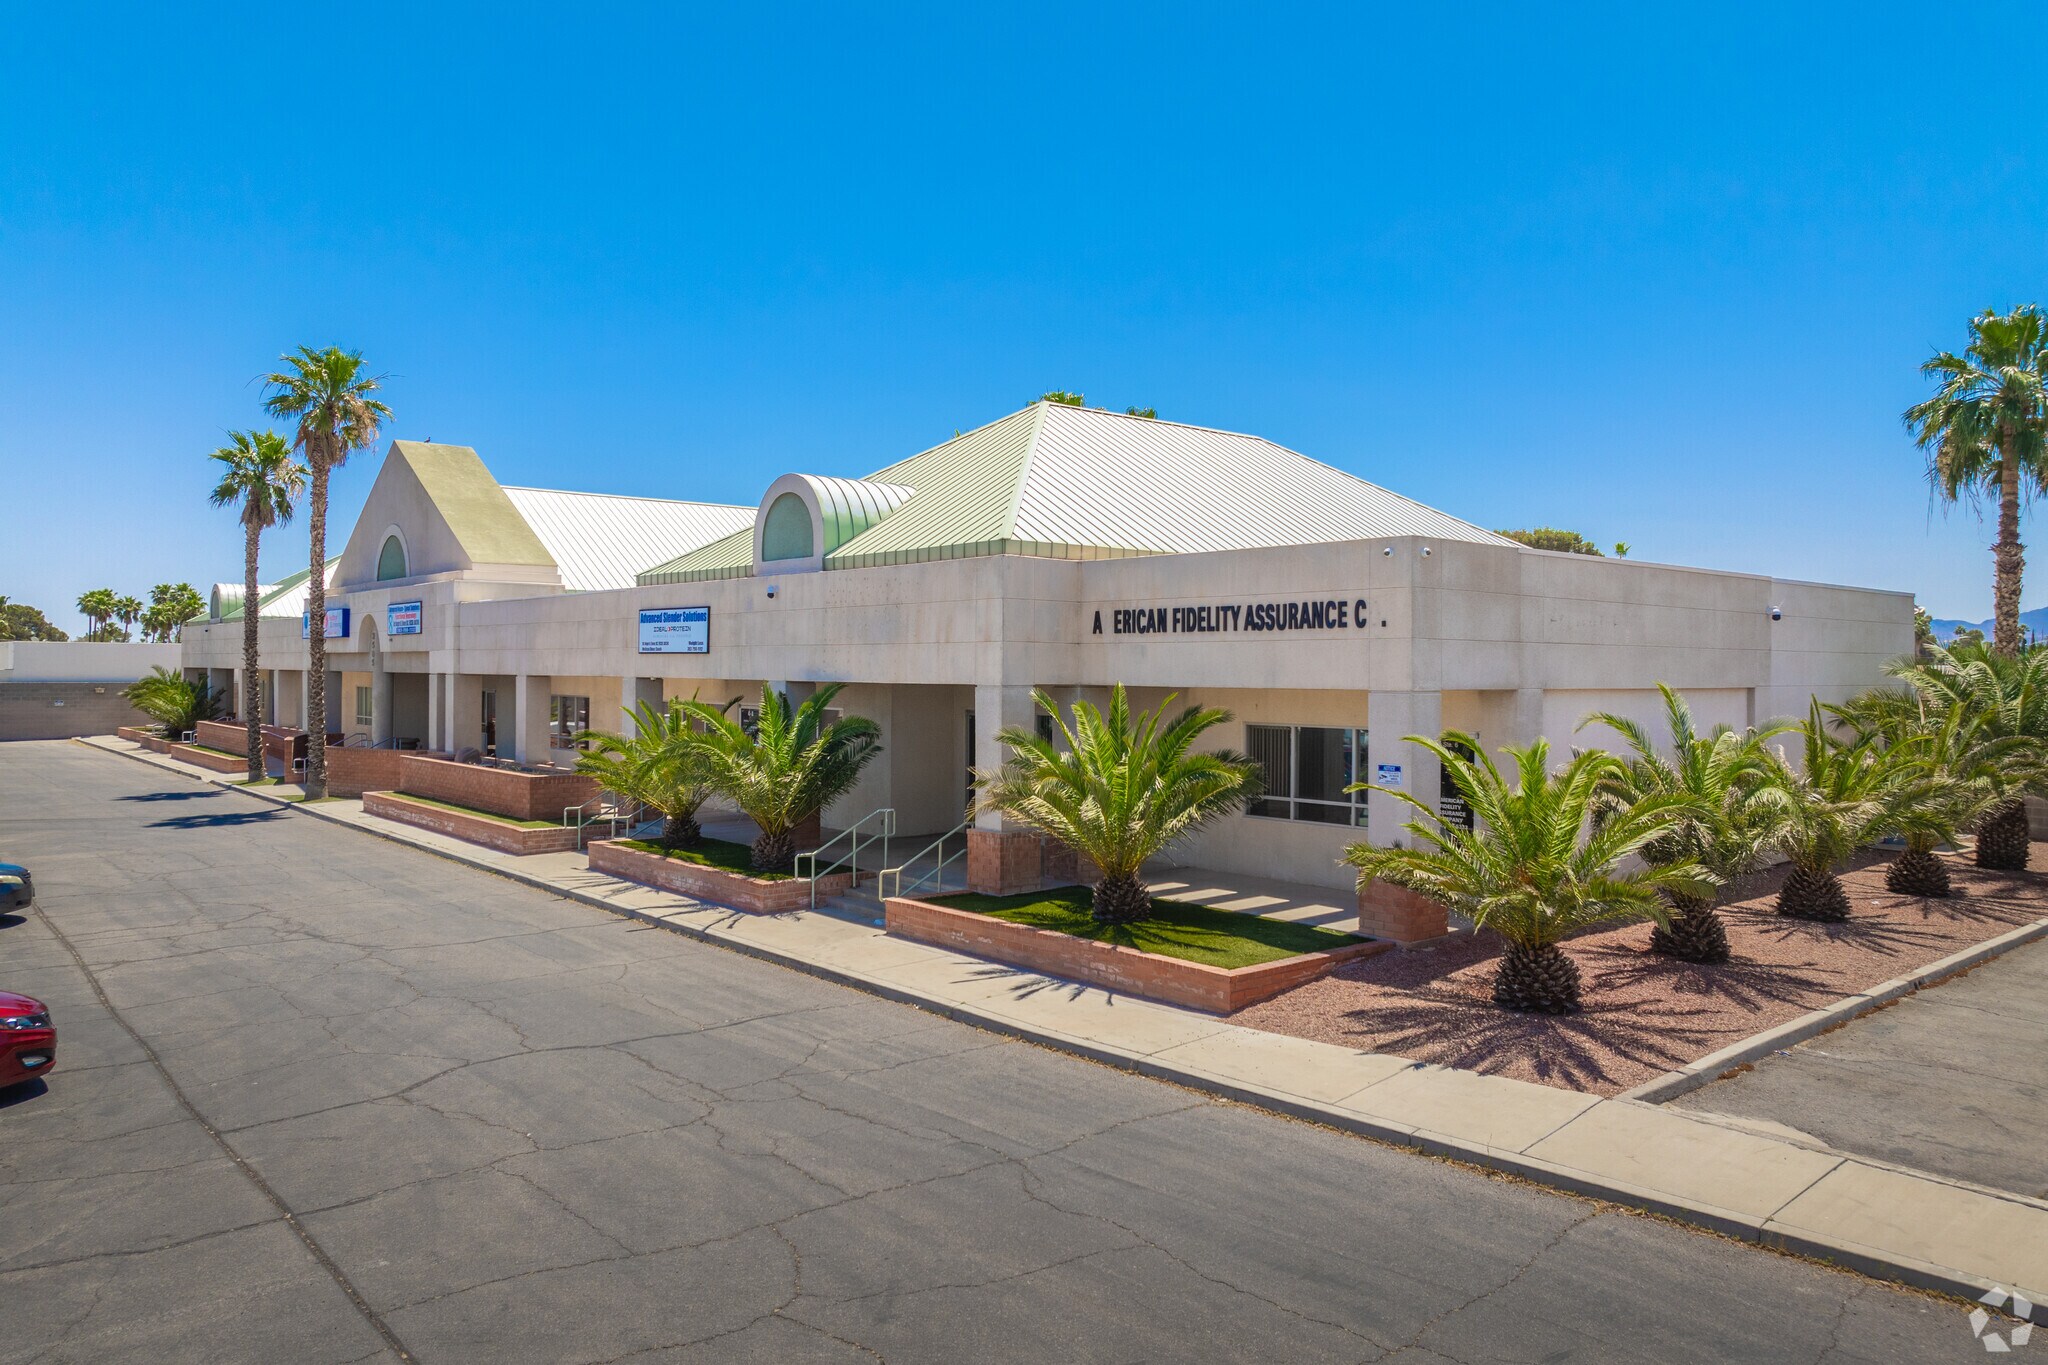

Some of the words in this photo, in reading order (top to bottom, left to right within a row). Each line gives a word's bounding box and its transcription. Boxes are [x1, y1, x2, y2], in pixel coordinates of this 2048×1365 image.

[641, 612, 663, 623] Advanced
[663, 612, 682, 623] Slender
[683, 611, 707, 622] Solutions
[1113, 607, 1168, 634] ERICAN
[1172, 605, 1241, 633] FIDELITY
[1244, 601, 1348, 632] ASSURANCE
